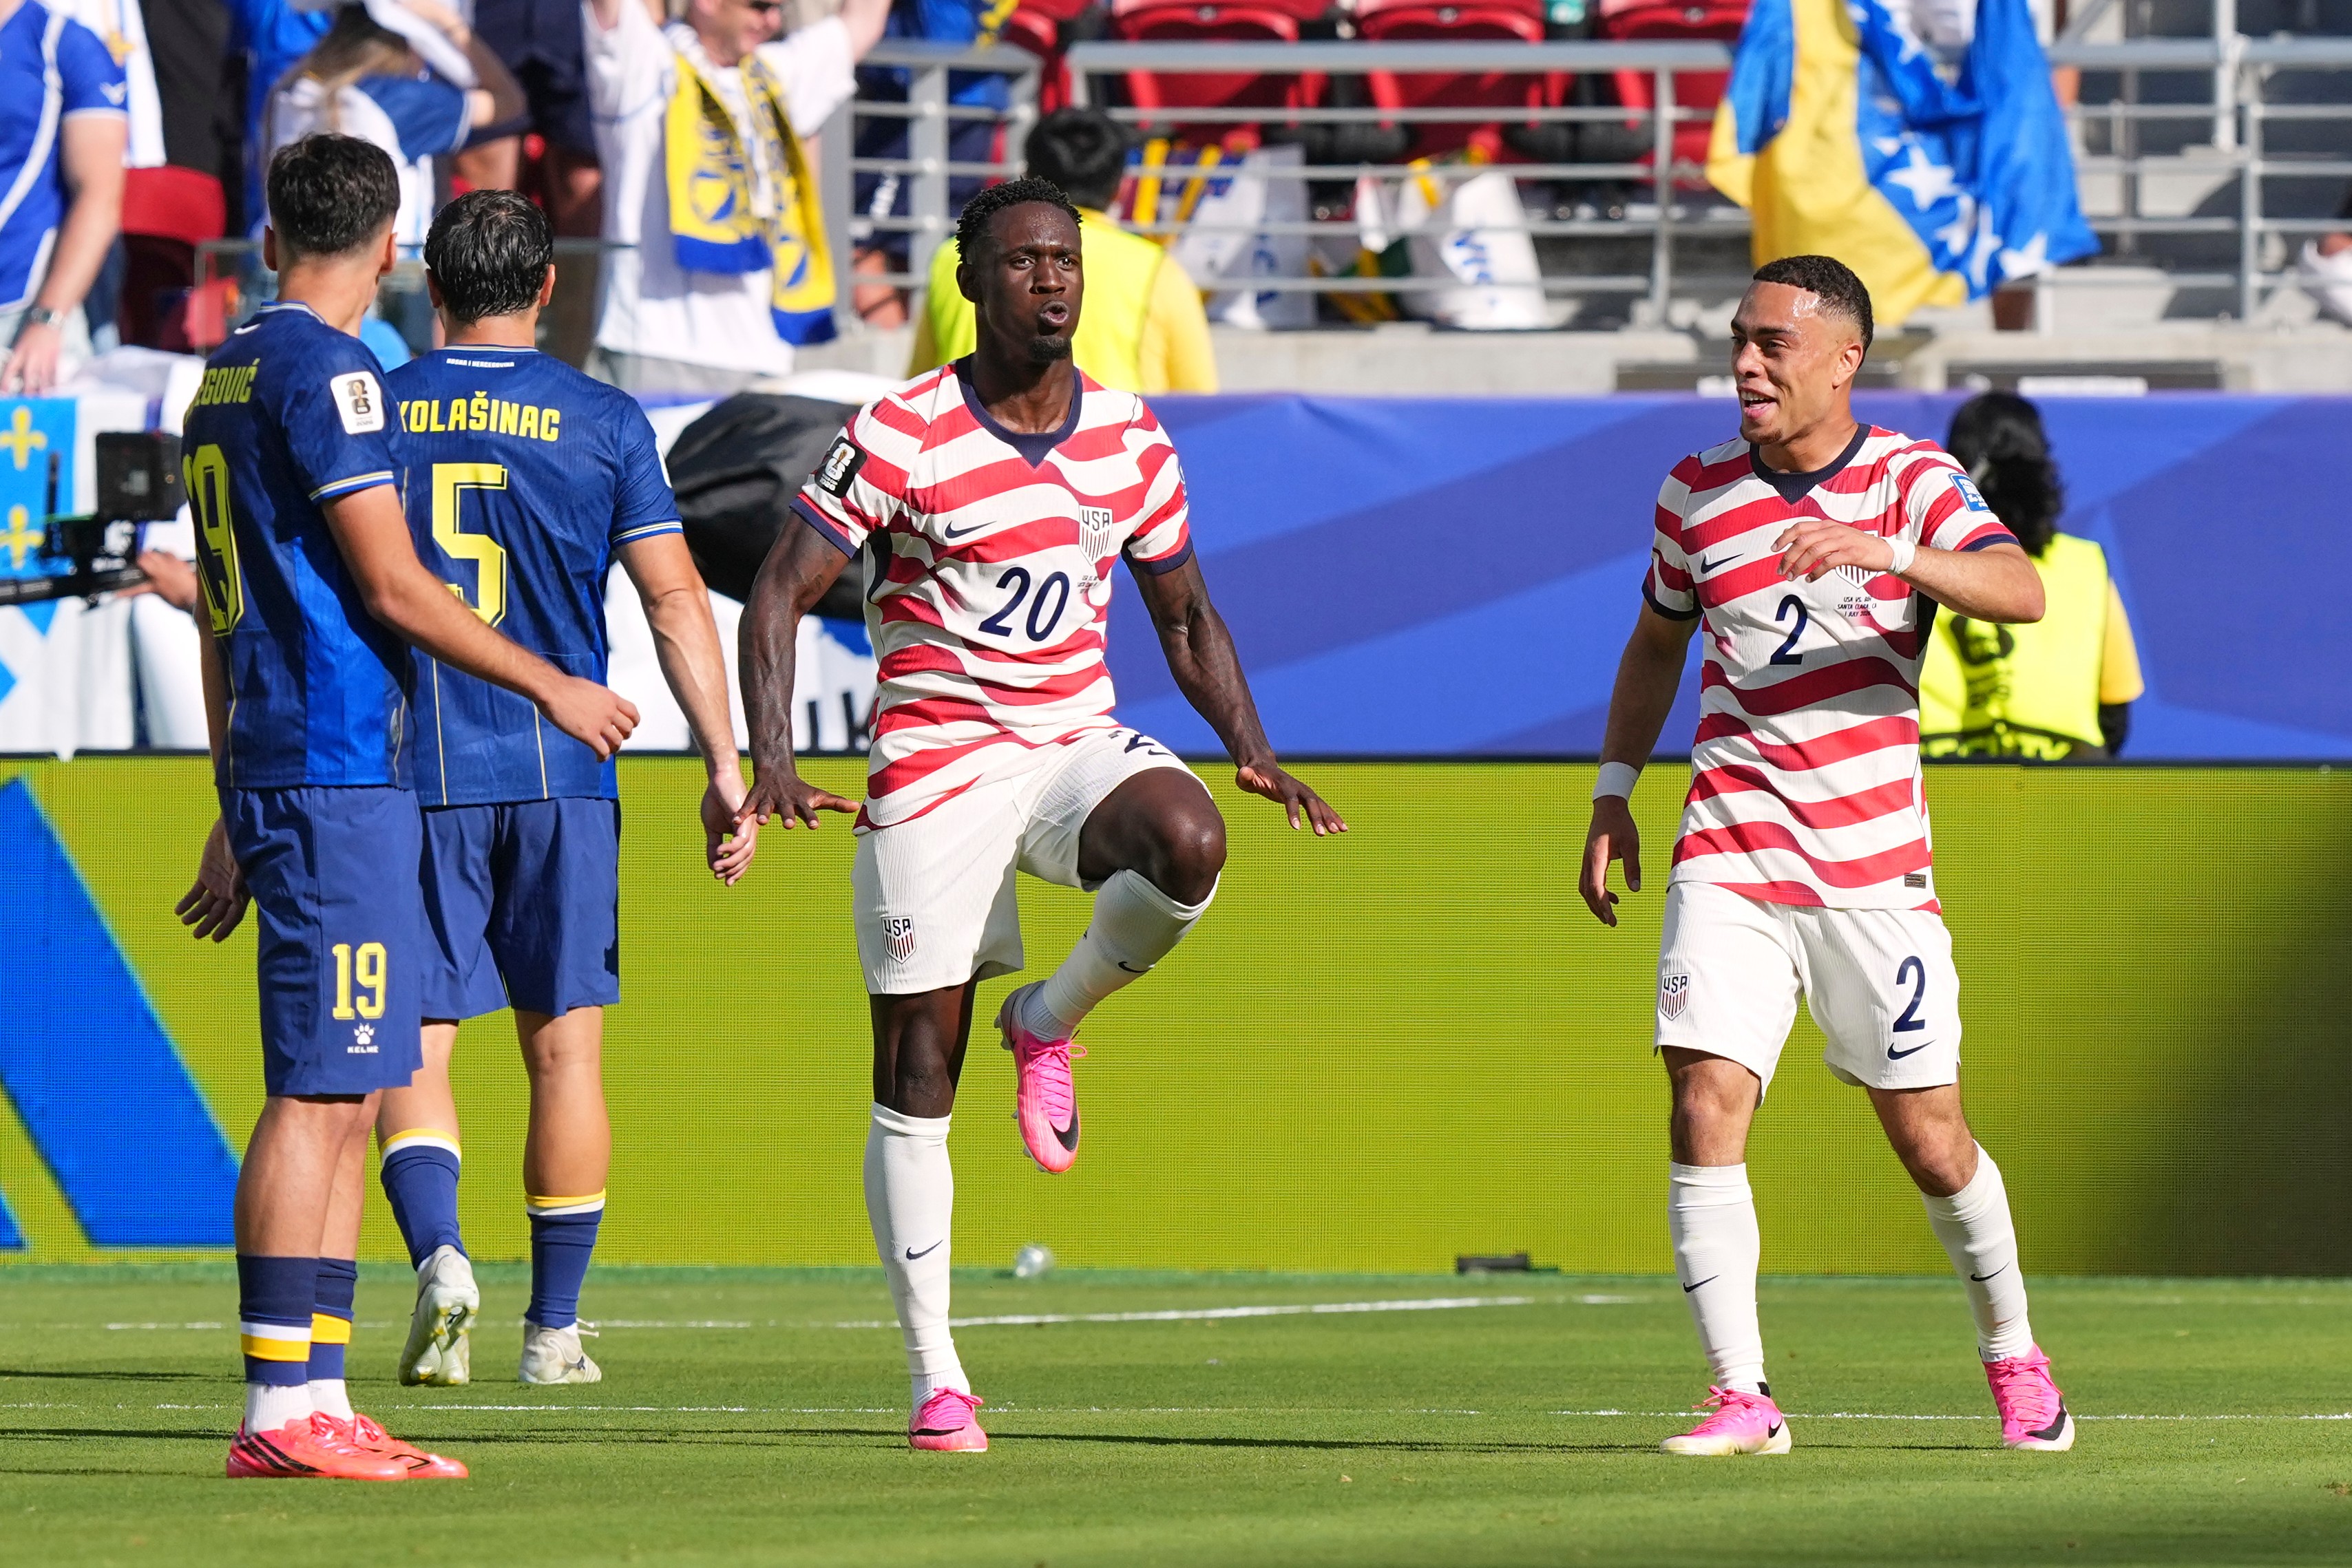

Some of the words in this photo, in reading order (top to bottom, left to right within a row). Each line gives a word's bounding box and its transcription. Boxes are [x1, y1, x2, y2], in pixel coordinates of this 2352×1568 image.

[432, 463, 507, 628] 5
[1082, 509, 1110, 531] USA
[978, 566, 1070, 642] 20
[1770, 594, 1807, 665] 2
[883, 918, 911, 937] USA
[332, 942, 387, 1020] 19
[1663, 975, 1688, 993] USA
[1893, 955, 1926, 1032] 2
[347, 1046, 379, 1054] KELME
